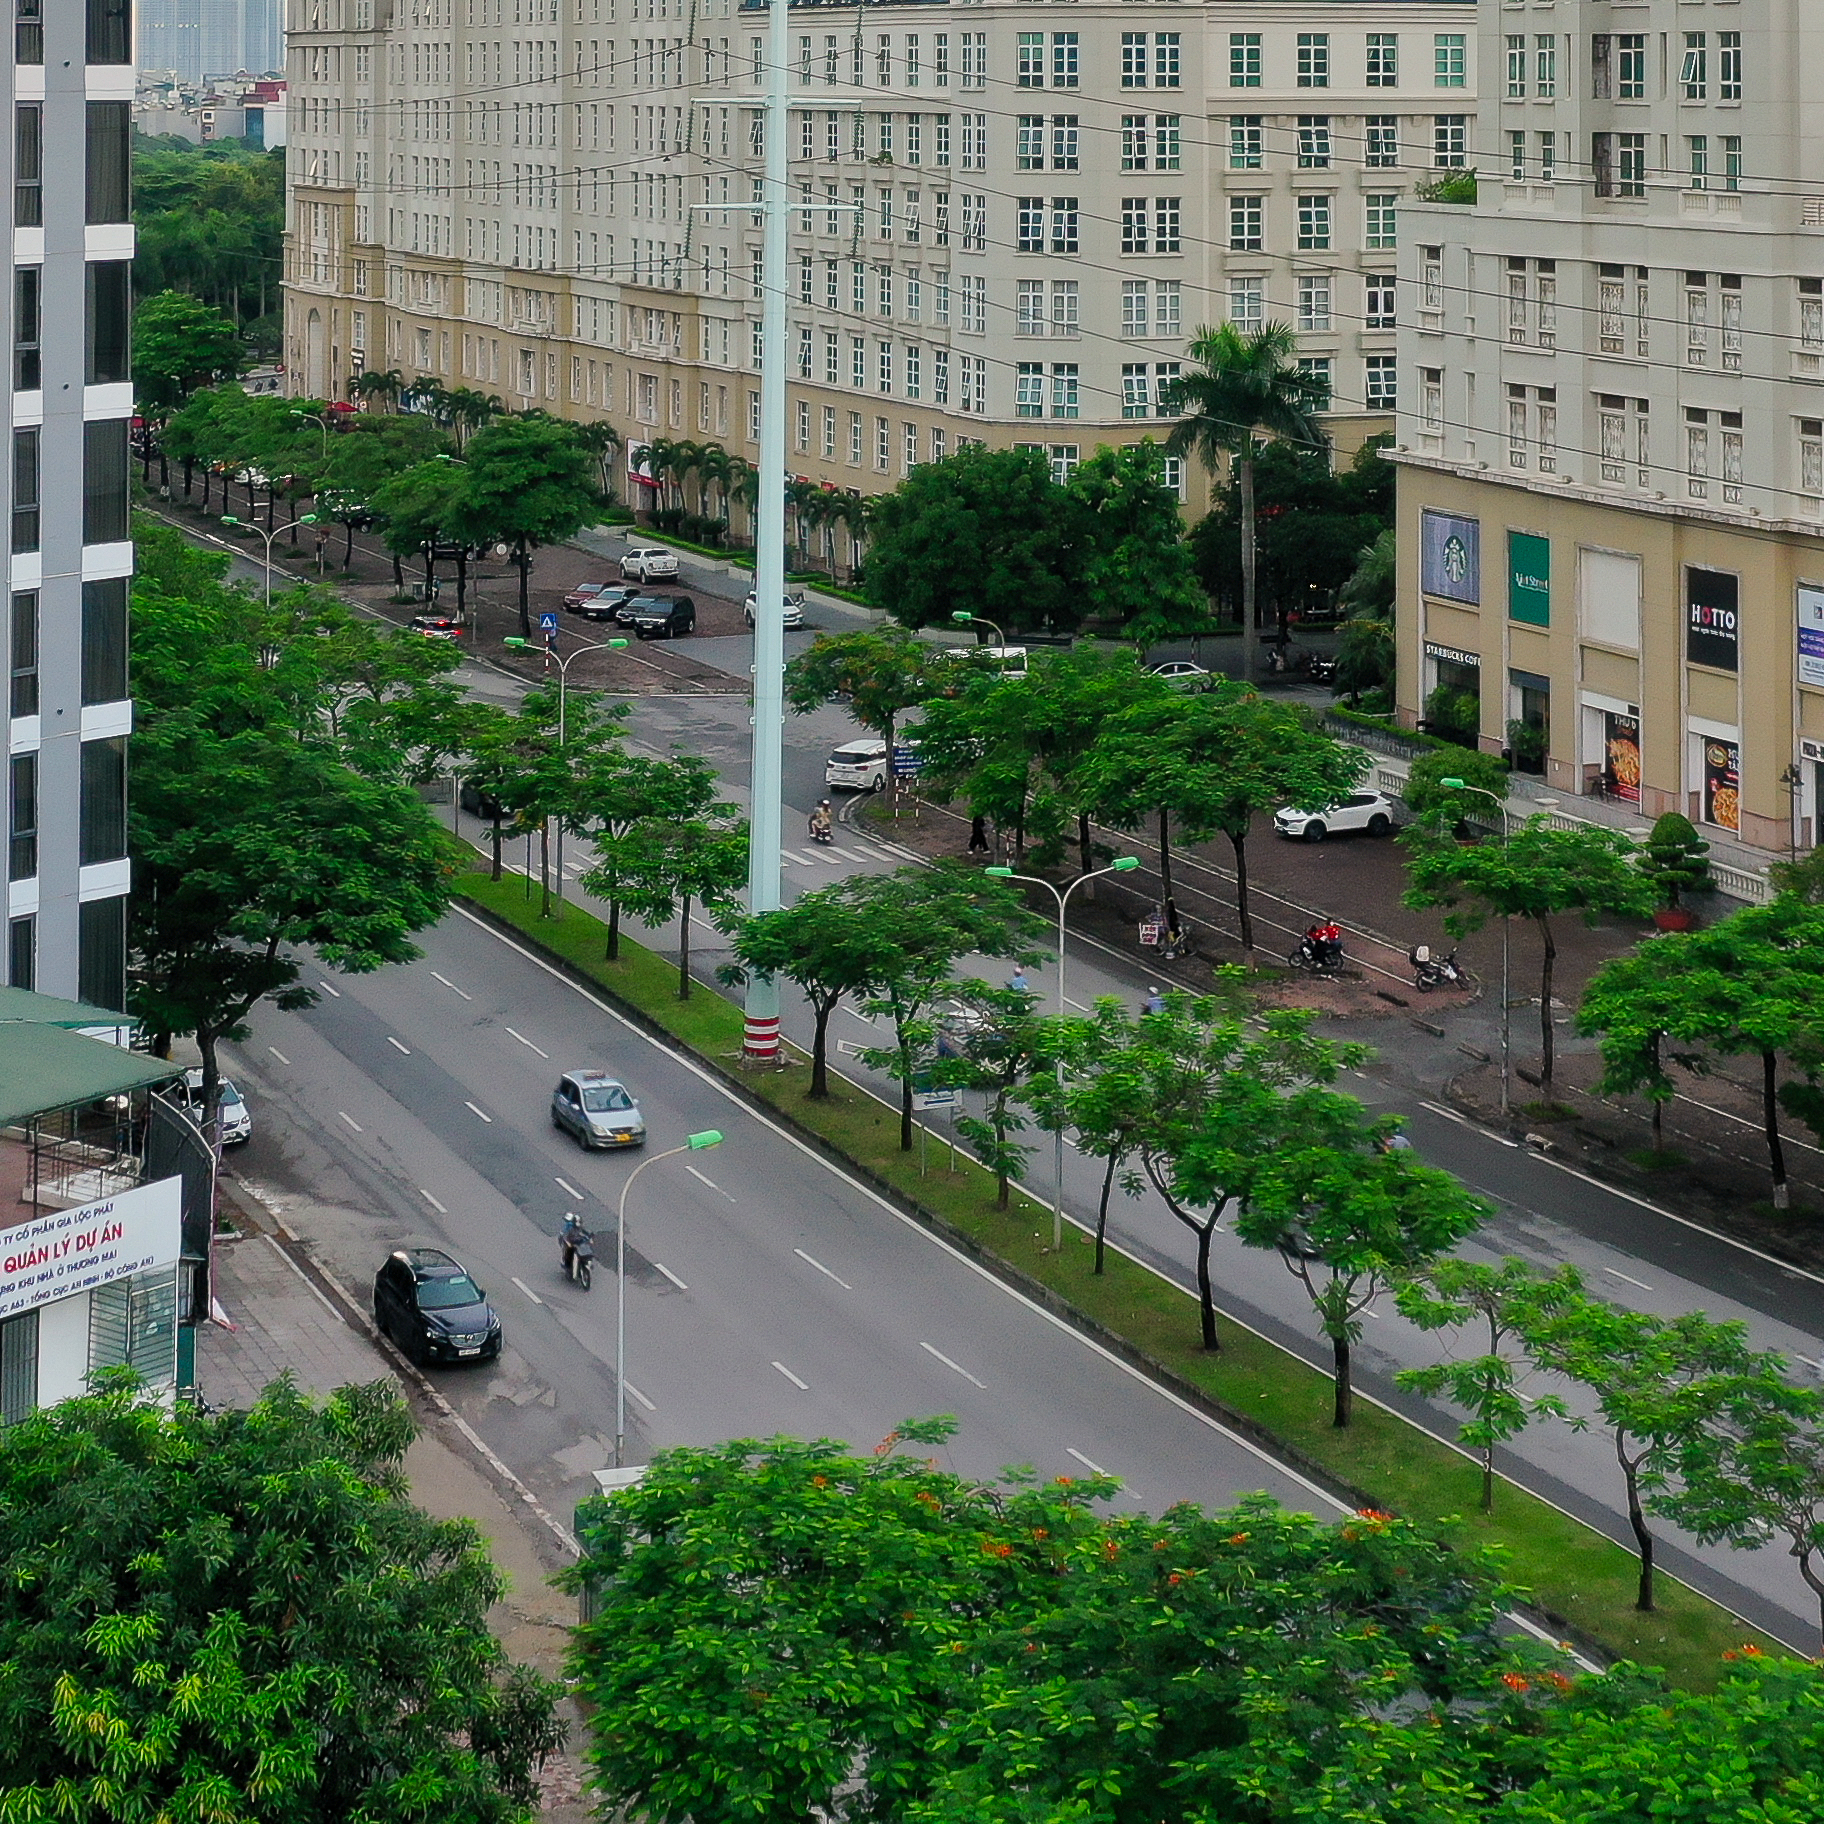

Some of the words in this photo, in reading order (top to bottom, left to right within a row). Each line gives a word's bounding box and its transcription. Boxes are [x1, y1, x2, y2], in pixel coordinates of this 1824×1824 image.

[1691, 603, 1735, 630] HOTTO
[1426, 644, 1464, 663] STARBUCKS
[3, 1242, 49, 1274] QUẢN
[53, 1232, 71, 1259] LÝ
[76, 1226, 99, 1253] DỰ
[101, 1220, 123, 1244] ÁN
